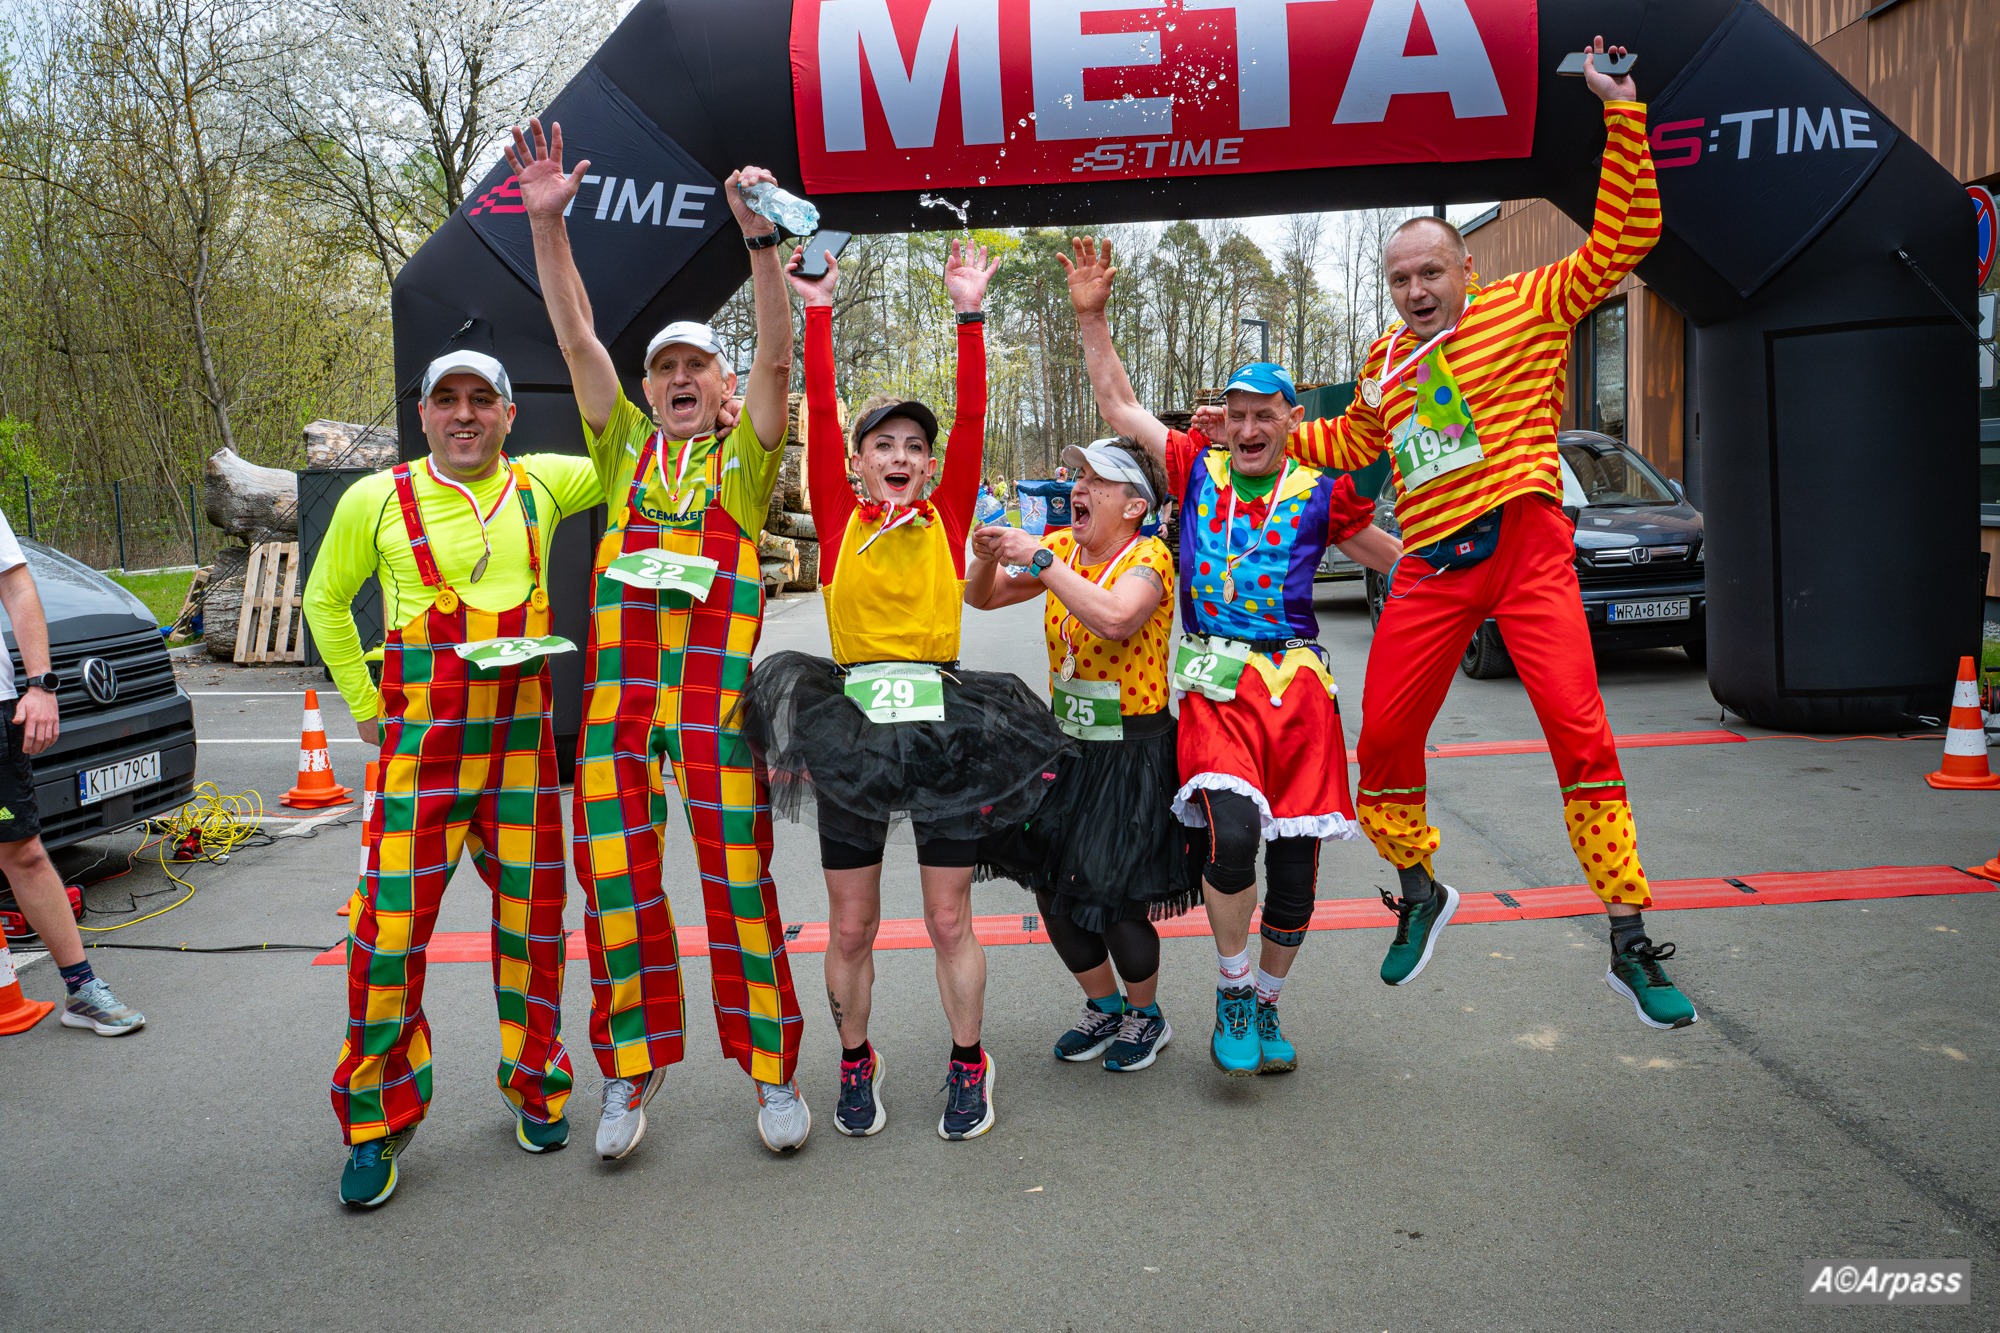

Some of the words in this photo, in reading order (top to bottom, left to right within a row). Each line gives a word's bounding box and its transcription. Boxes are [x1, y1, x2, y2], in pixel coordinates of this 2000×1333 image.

[818, 0, 1509, 152] META
[1072, 137, 1244, 173] S:TIME
[1404, 430, 1460, 469] 195
[637, 558, 685, 581] 22
[1616, 604, 1642, 619] WRA
[1646, 601, 1688, 617] 8165F
[492, 639, 540, 656] 23
[1183, 653, 1218, 682] 62
[871, 679, 914, 708] 29
[1065, 695, 1095, 726] 25
[90, 765, 118, 795] KTT
[124, 755, 156, 785] 79C1
